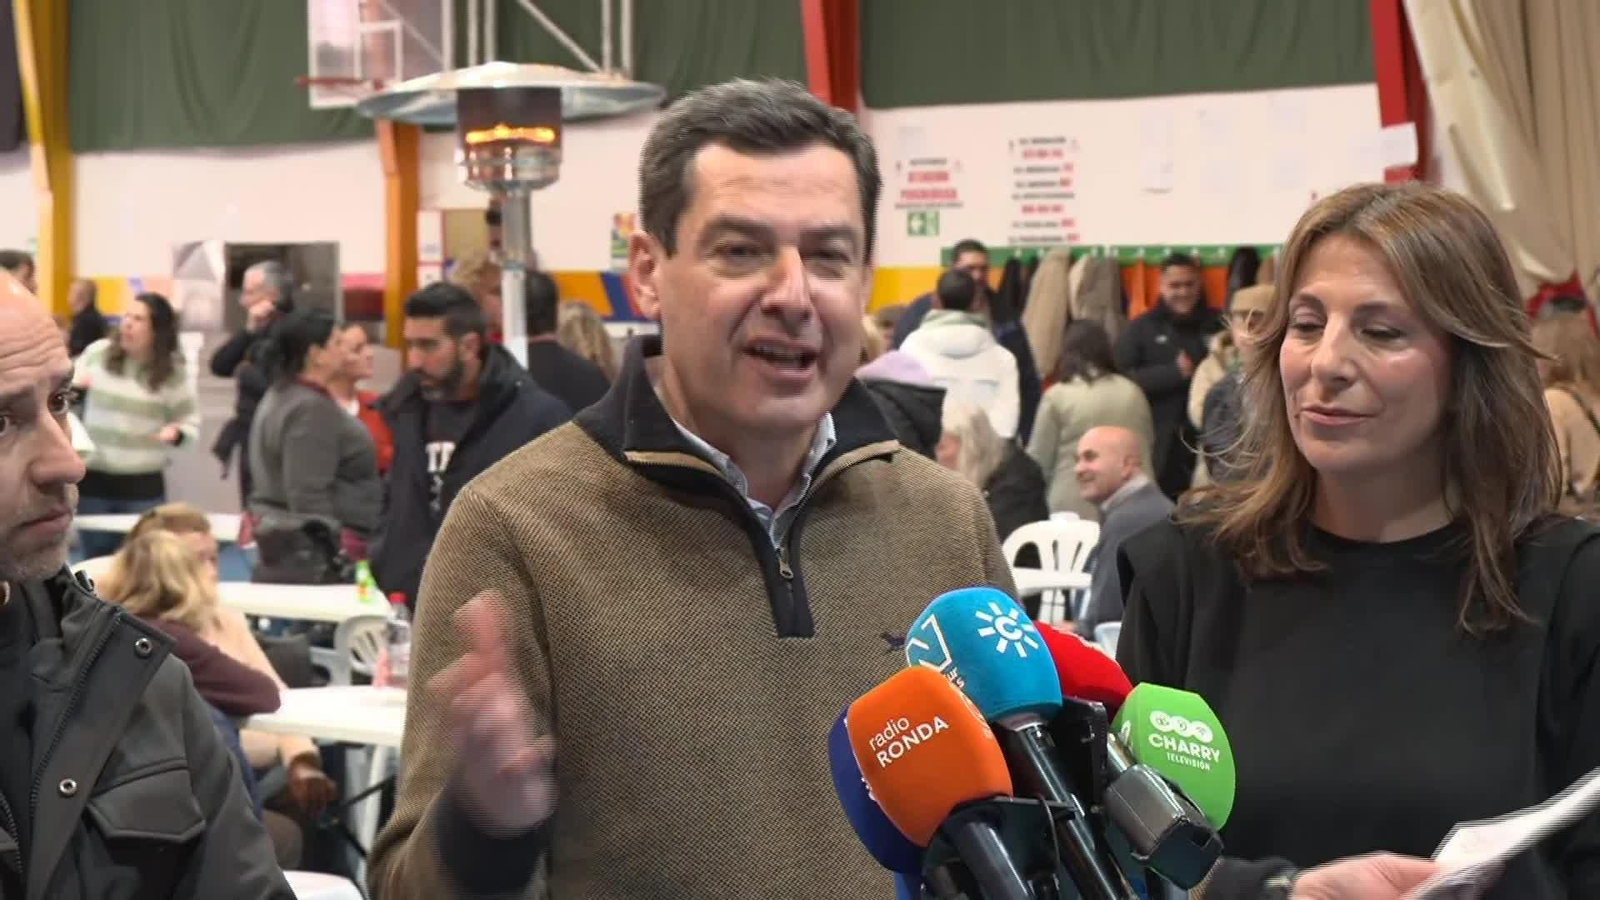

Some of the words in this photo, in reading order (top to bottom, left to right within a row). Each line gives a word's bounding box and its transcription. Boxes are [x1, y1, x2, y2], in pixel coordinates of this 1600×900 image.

[868, 717, 910, 751] radio
[876, 715, 950, 768] RONDA
[1147, 733, 1220, 763] CHARRY
[1166, 751, 1211, 771] TELEVISIÓN
